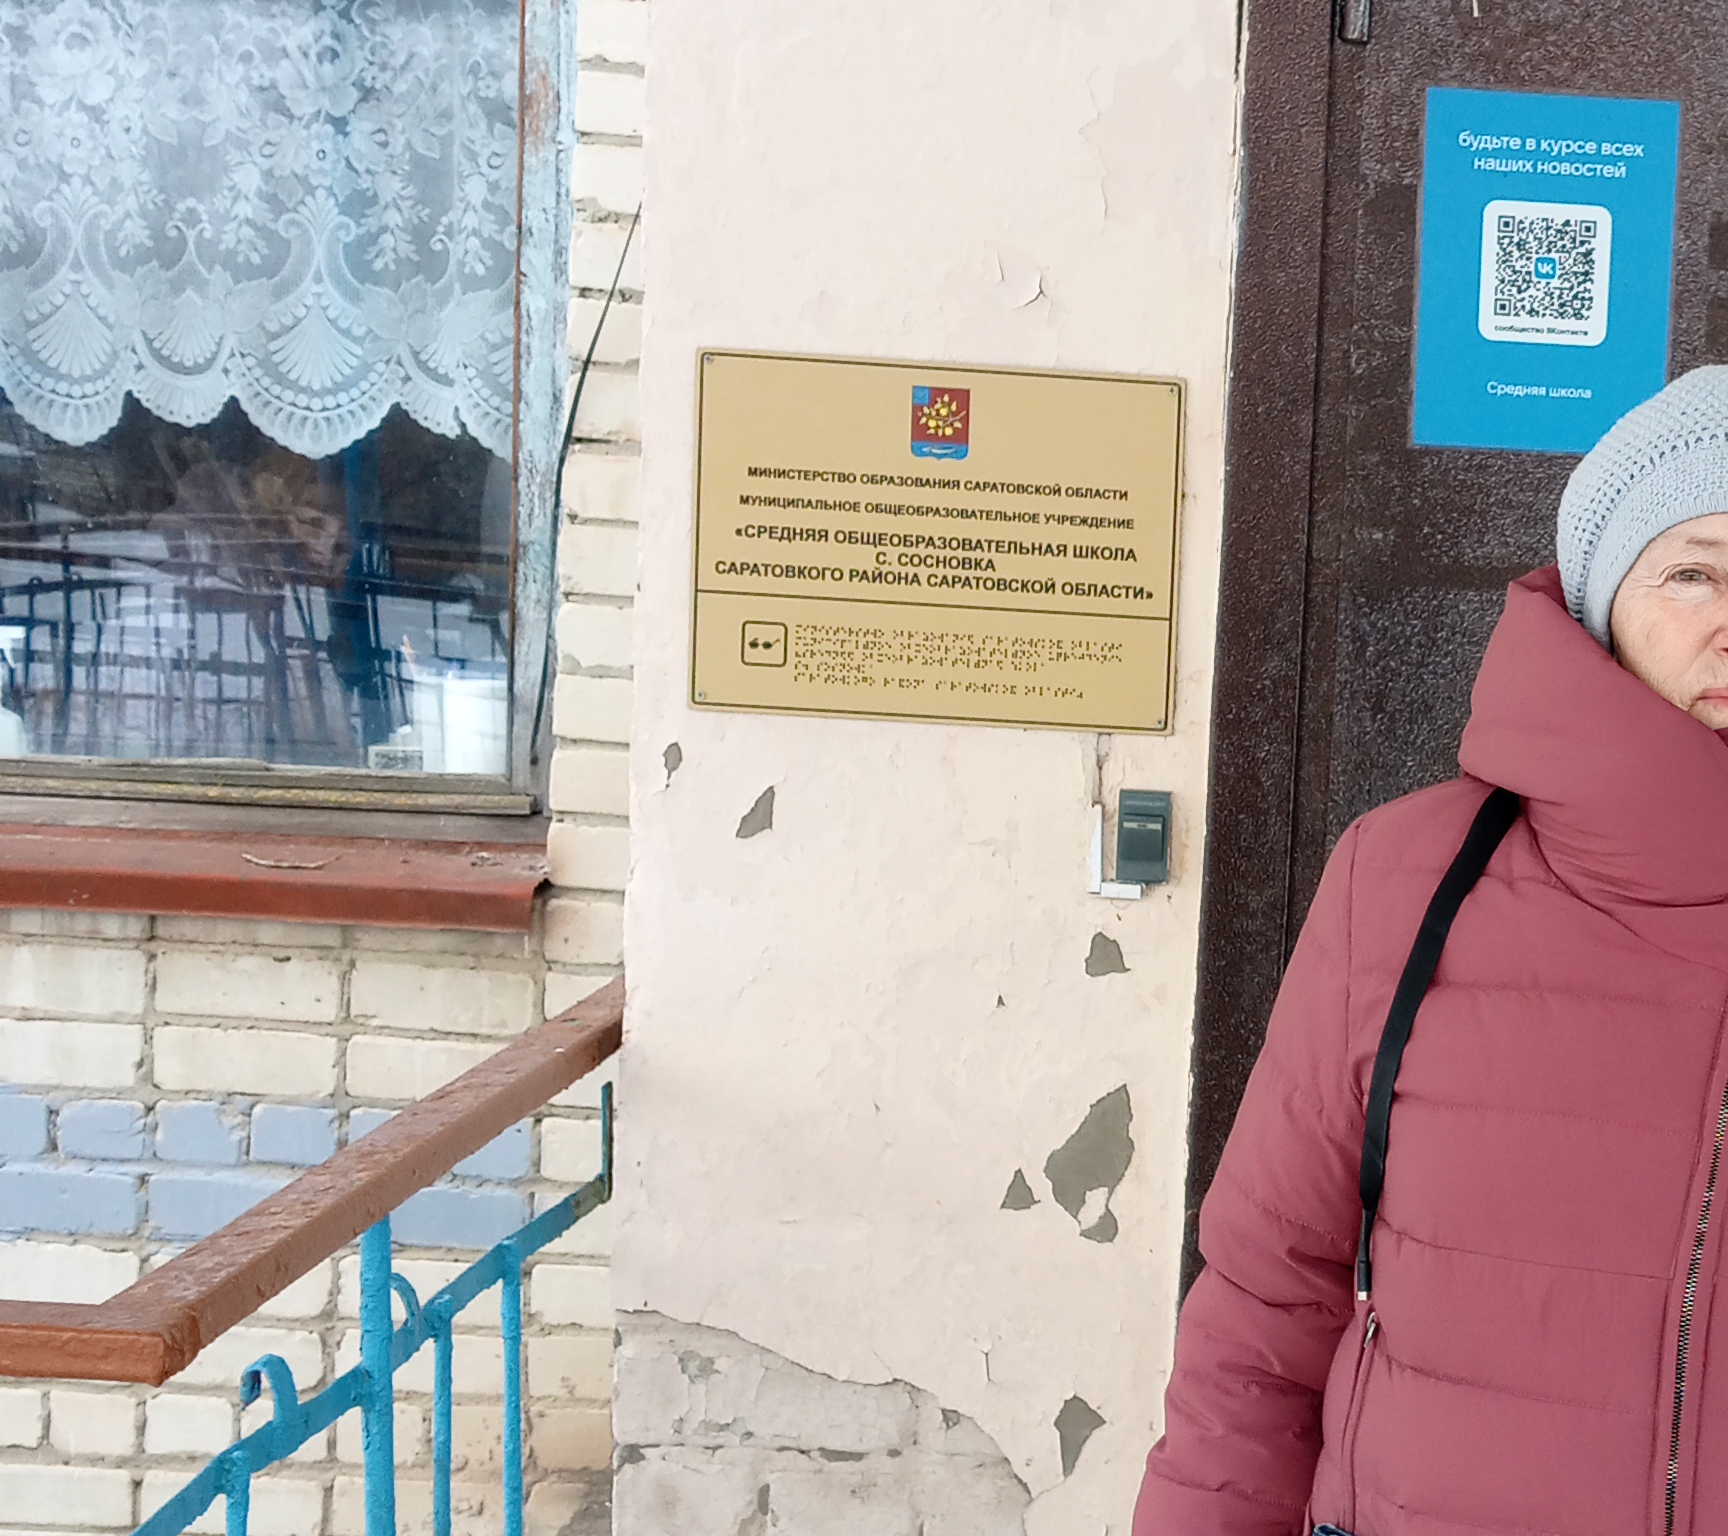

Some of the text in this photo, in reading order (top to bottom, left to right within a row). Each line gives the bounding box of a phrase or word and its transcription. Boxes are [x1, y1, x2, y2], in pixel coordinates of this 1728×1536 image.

[1458, 130, 1644, 158] будьте в курсе всех
[1473, 158, 1626, 178] наших новостей
[1487, 381, 1592, 399] Средняя школа
[748, 467, 1128, 501] МИНИСТЕРСТВО ОБРАЗОВАНИЯ САРАТОВСКОЙ ОБЛАСТИ
[740, 495, 1135, 530] МУНИЦИПАЛЬНОЕ ОБЩЕОБРАЗОВАТЕЛЬНОЕ УЧРЕЖДЕНИЕ
[735, 524, 1137, 562] «СРЕДНЯЯ ОБЩЕОБРАЗОВАТЕЛЬНАЯ ШКОЛА
[875, 551, 996, 572] С. СОСНОВКА
[715, 560, 1154, 600] САРАТОВКОГО РАЙОНА САРАТОВСКОЙ ОБЛАСТИ»
